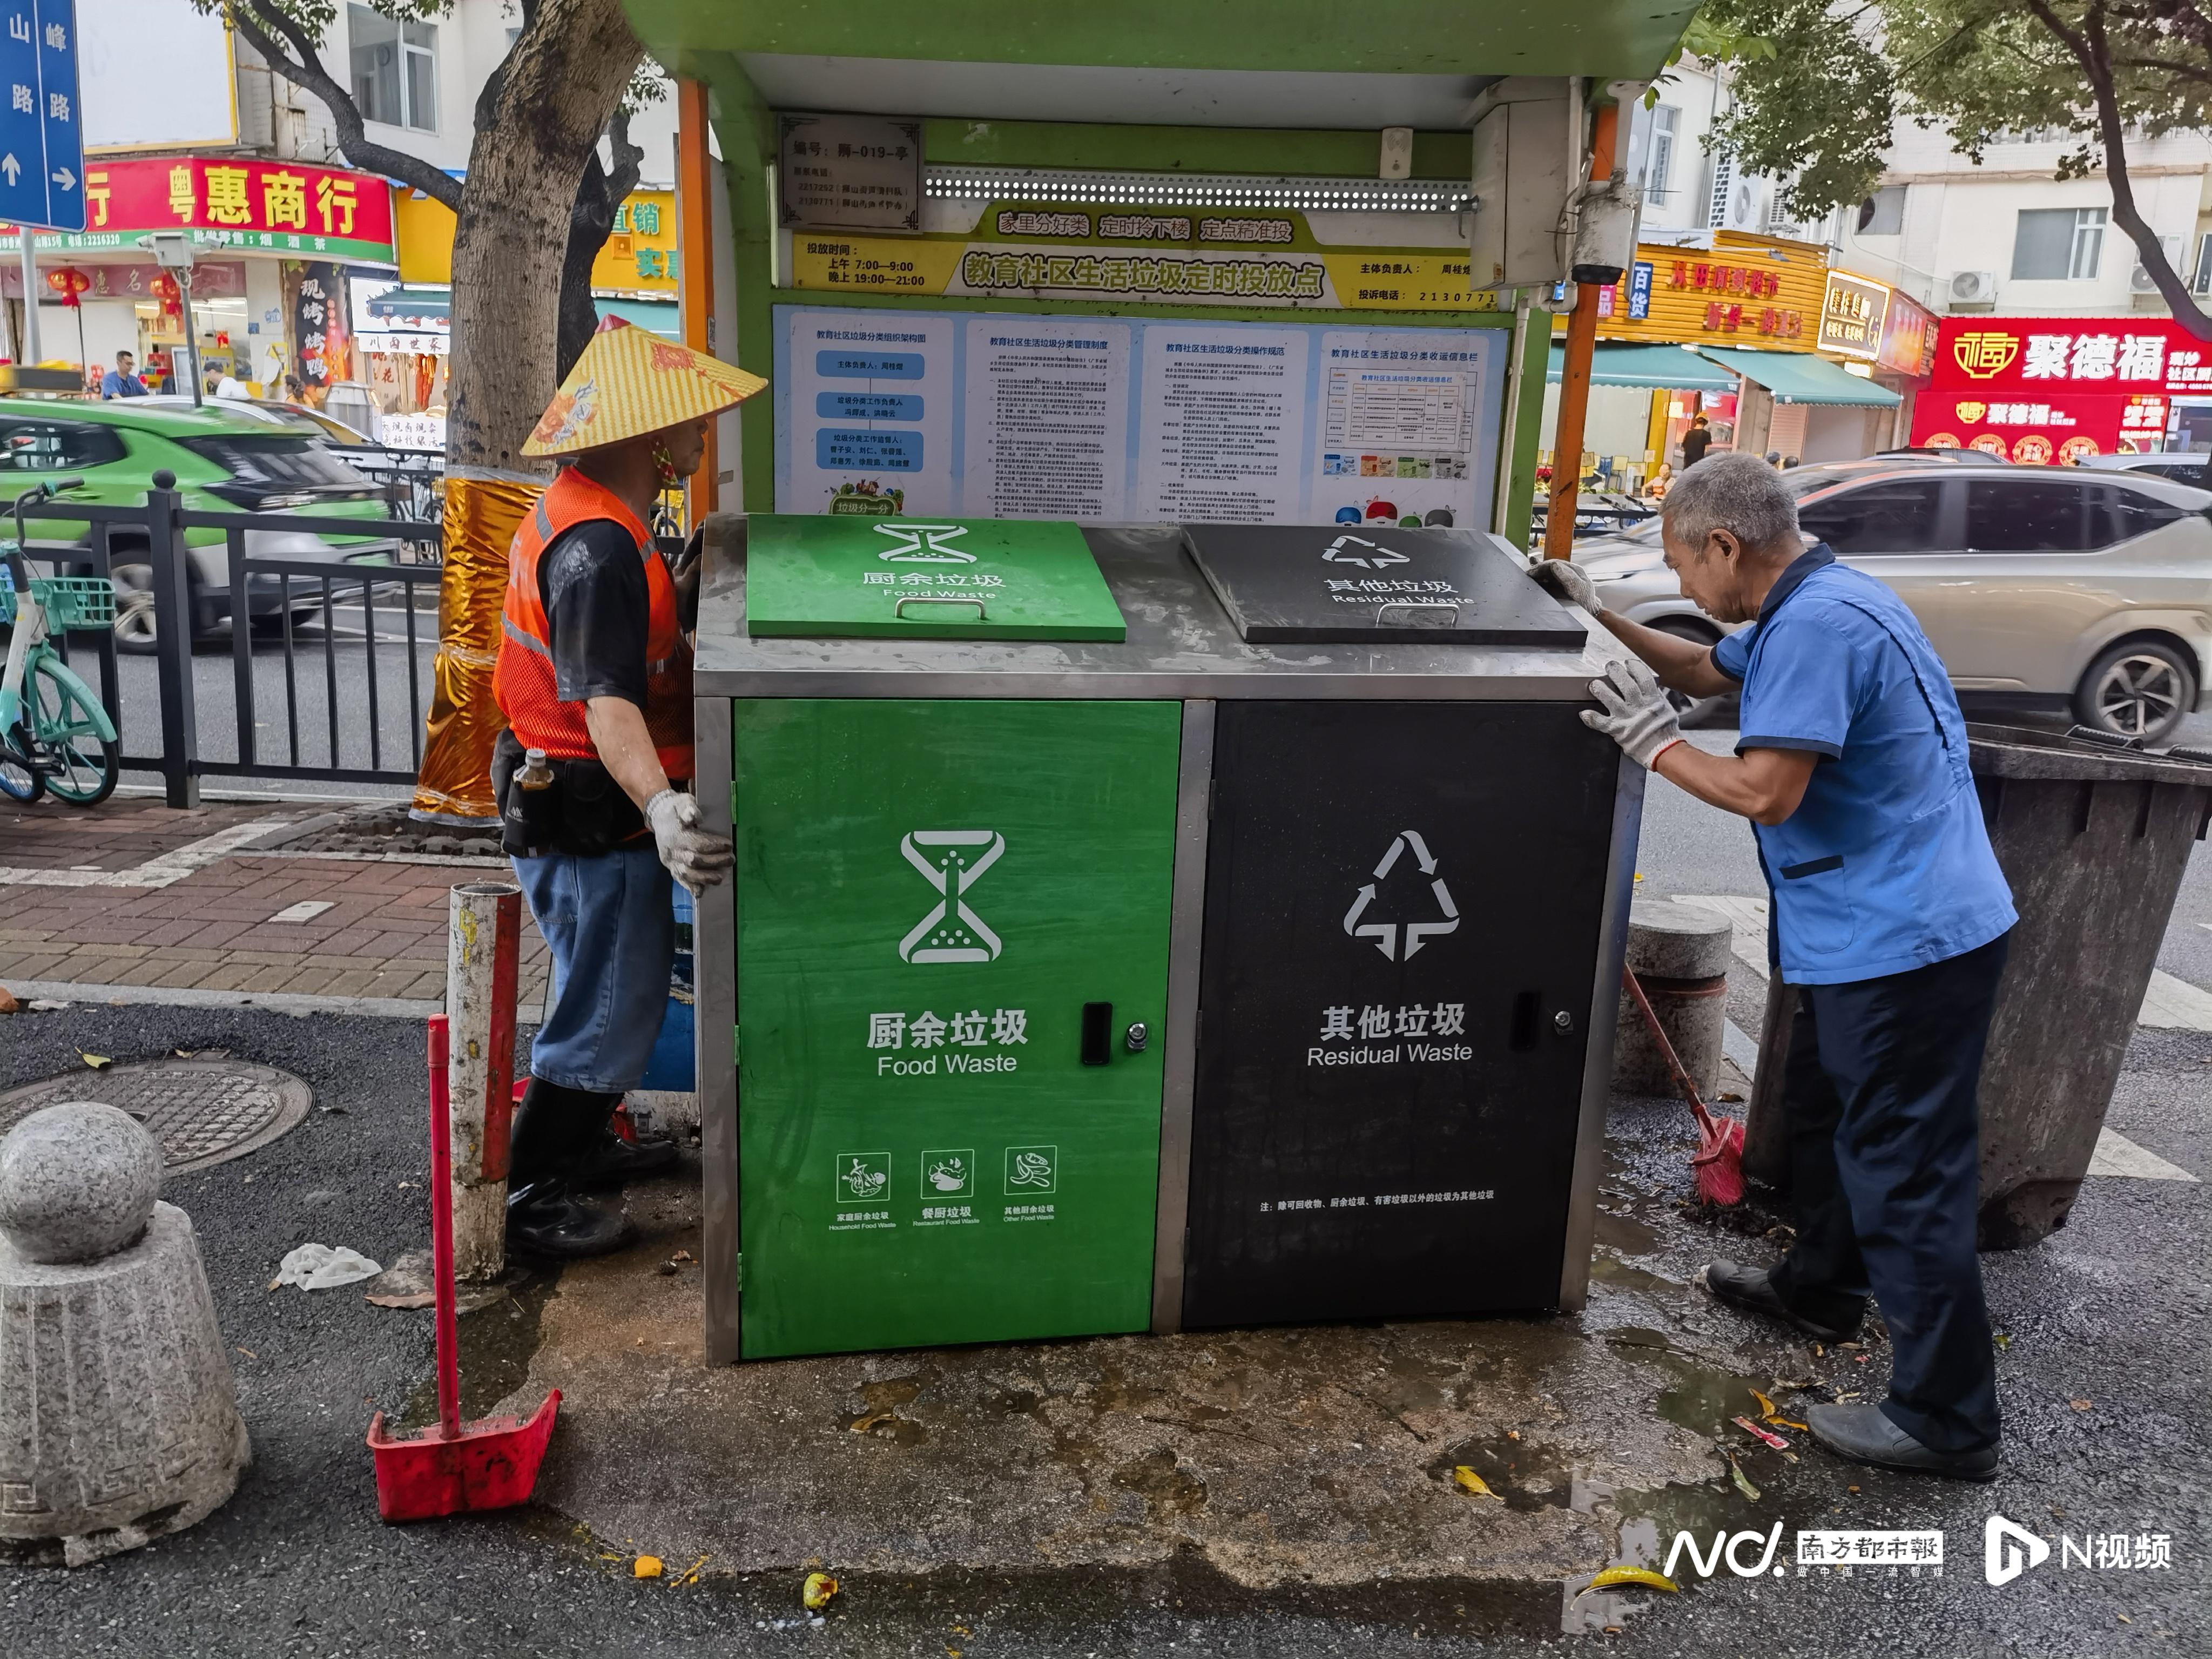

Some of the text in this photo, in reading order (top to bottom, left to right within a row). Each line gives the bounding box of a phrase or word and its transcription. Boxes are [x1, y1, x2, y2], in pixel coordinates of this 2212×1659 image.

[168, 165, 358, 234] 粤惠商行
[999, 213, 1293, 242] 家里分好类 定时拎下楼 定点精准投
[807, 242, 858, 256] 投放时间：
[828, 258, 850, 270] 上午
[1360, 263, 1420, 275] 主体负责人：
[828, 272, 850, 284] 晚上
[966, 252, 1324, 298] 教育社区生活垃圾定时投放点
[1358, 289, 1406, 300] 投诉电话：
[1630, 266, 1651, 317] 百货
[300, 278, 328, 380] 现烤烤鸭
[817, 330, 926, 343] 教育社区垃圾分类组织架构图
[989, 336, 1109, 350] 教育社区生活垃圾分类管理制度
[1165, 343, 1285, 356] 教育社区生活垃圾分类操作规范
[1331, 348, 1479, 362] 教育社区生活垃圾分类收运信息栏
[2021, 333, 2167, 381] 聚德福
[1986, 403, 2051, 426] 聚德福
[863, 572, 1006, 588] 厨余垃圾
[1324, 579, 1459, 593] 其他垃圾
[884, 589, 996, 599] Food Waste
[1332, 595, 1475, 605] Residual Waste
[867, 1009, 1028, 1049] 厨余垃圾
[1320, 1003, 1466, 1041] 其他垃圾
[1307, 1043, 1473, 1066] Residual Waste
[878, 1053, 1017, 1076] Food Waste
[837, 1211, 889, 1222] 家庭厨余垃圾
[922, 1206, 972, 1219] 餐厨垃圾
[1004, 1204, 1055, 1215] 其他厨余垃圾
